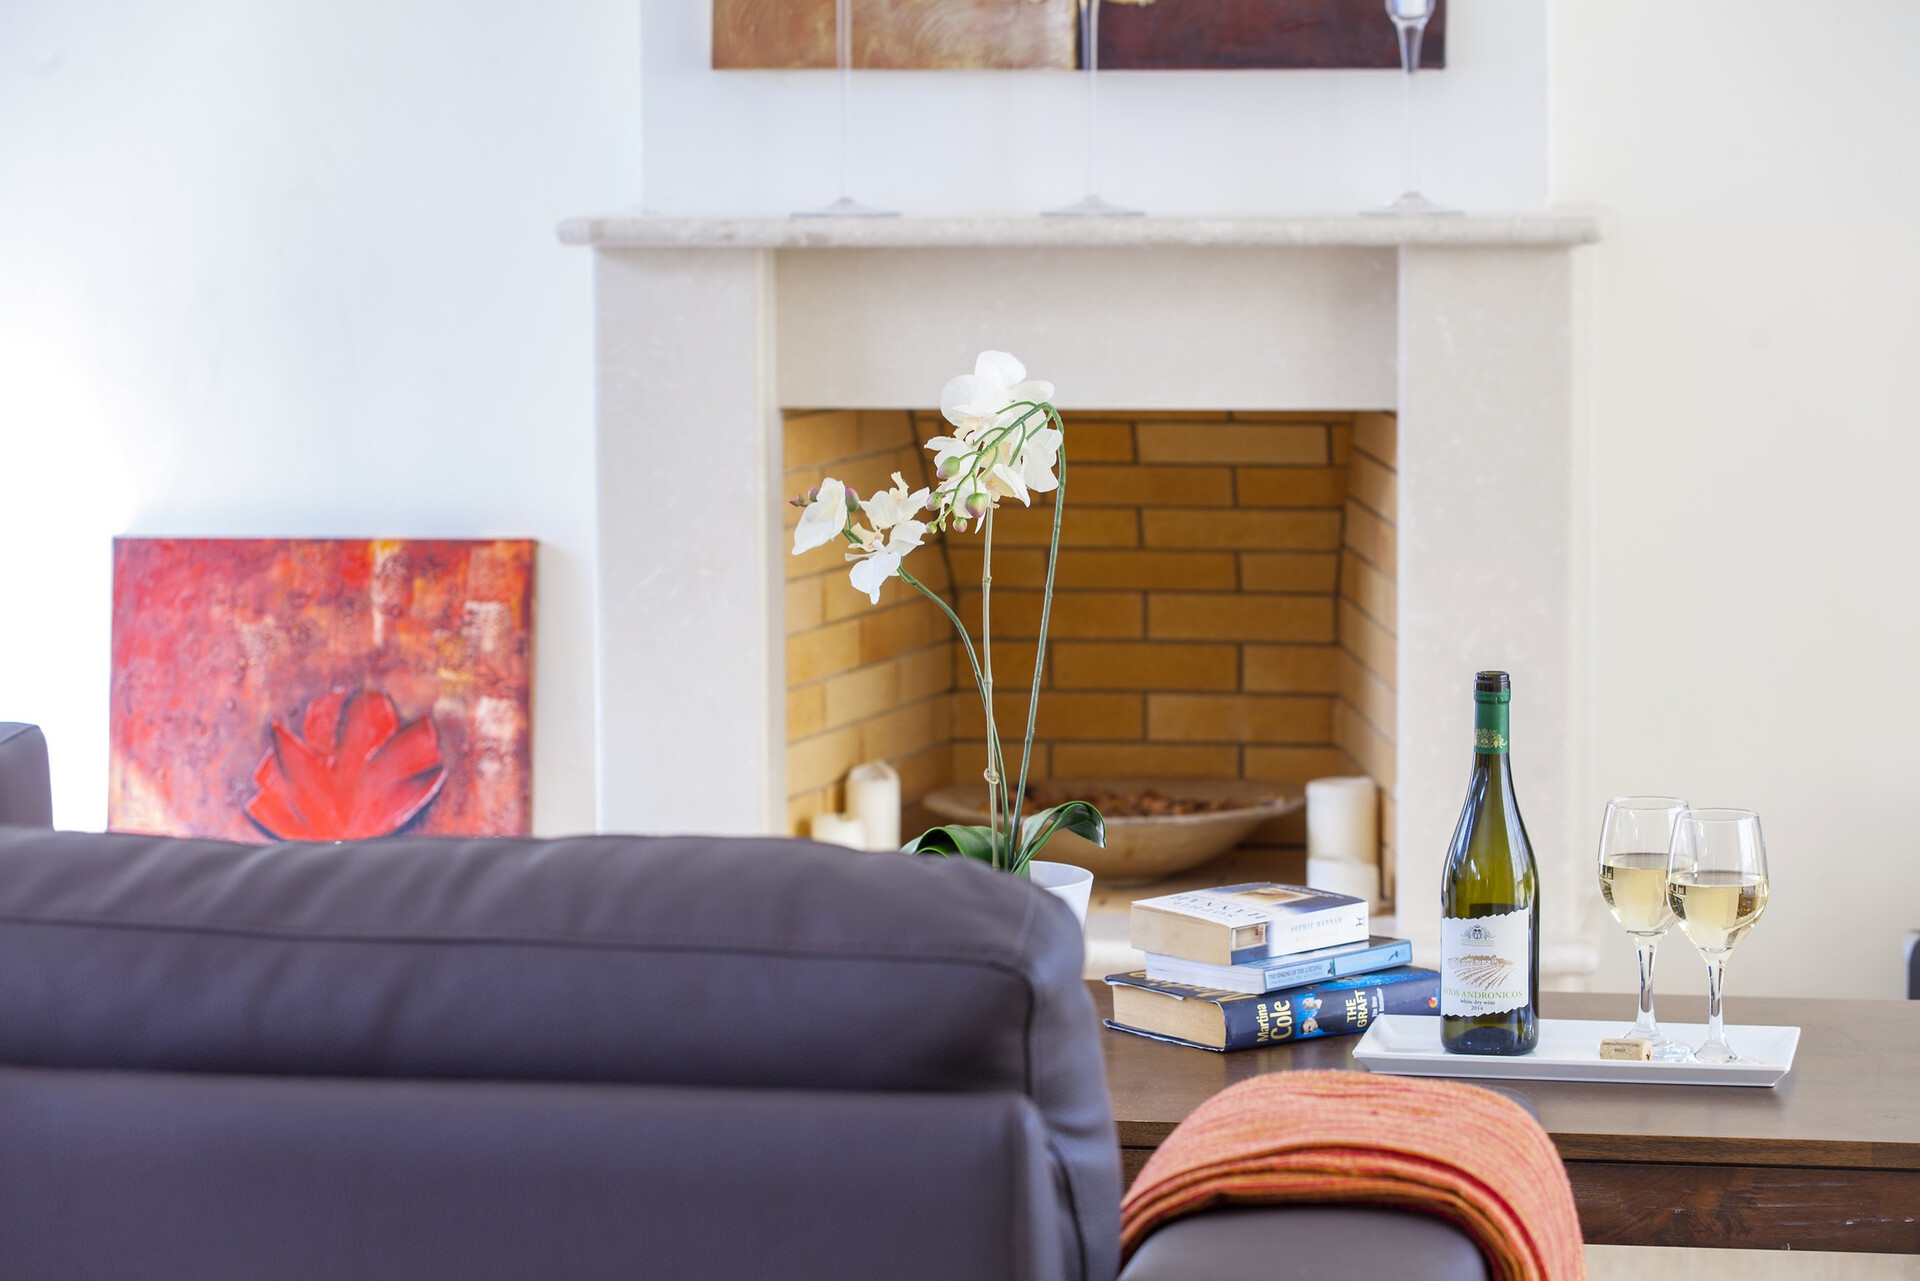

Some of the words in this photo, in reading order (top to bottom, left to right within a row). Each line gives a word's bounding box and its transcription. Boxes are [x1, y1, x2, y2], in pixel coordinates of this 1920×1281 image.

[1291, 922, 1313, 933] SOPHIE
[1316, 917, 1342, 927] HANNAH
[1354, 989, 1368, 1028] GRAFT
[1461, 989, 1523, 999] ANDRONICOS
[1256, 1003, 1270, 1042] Martina
[1269, 999, 1293, 1040] Cole
[1345, 998, 1357, 1023] THE
